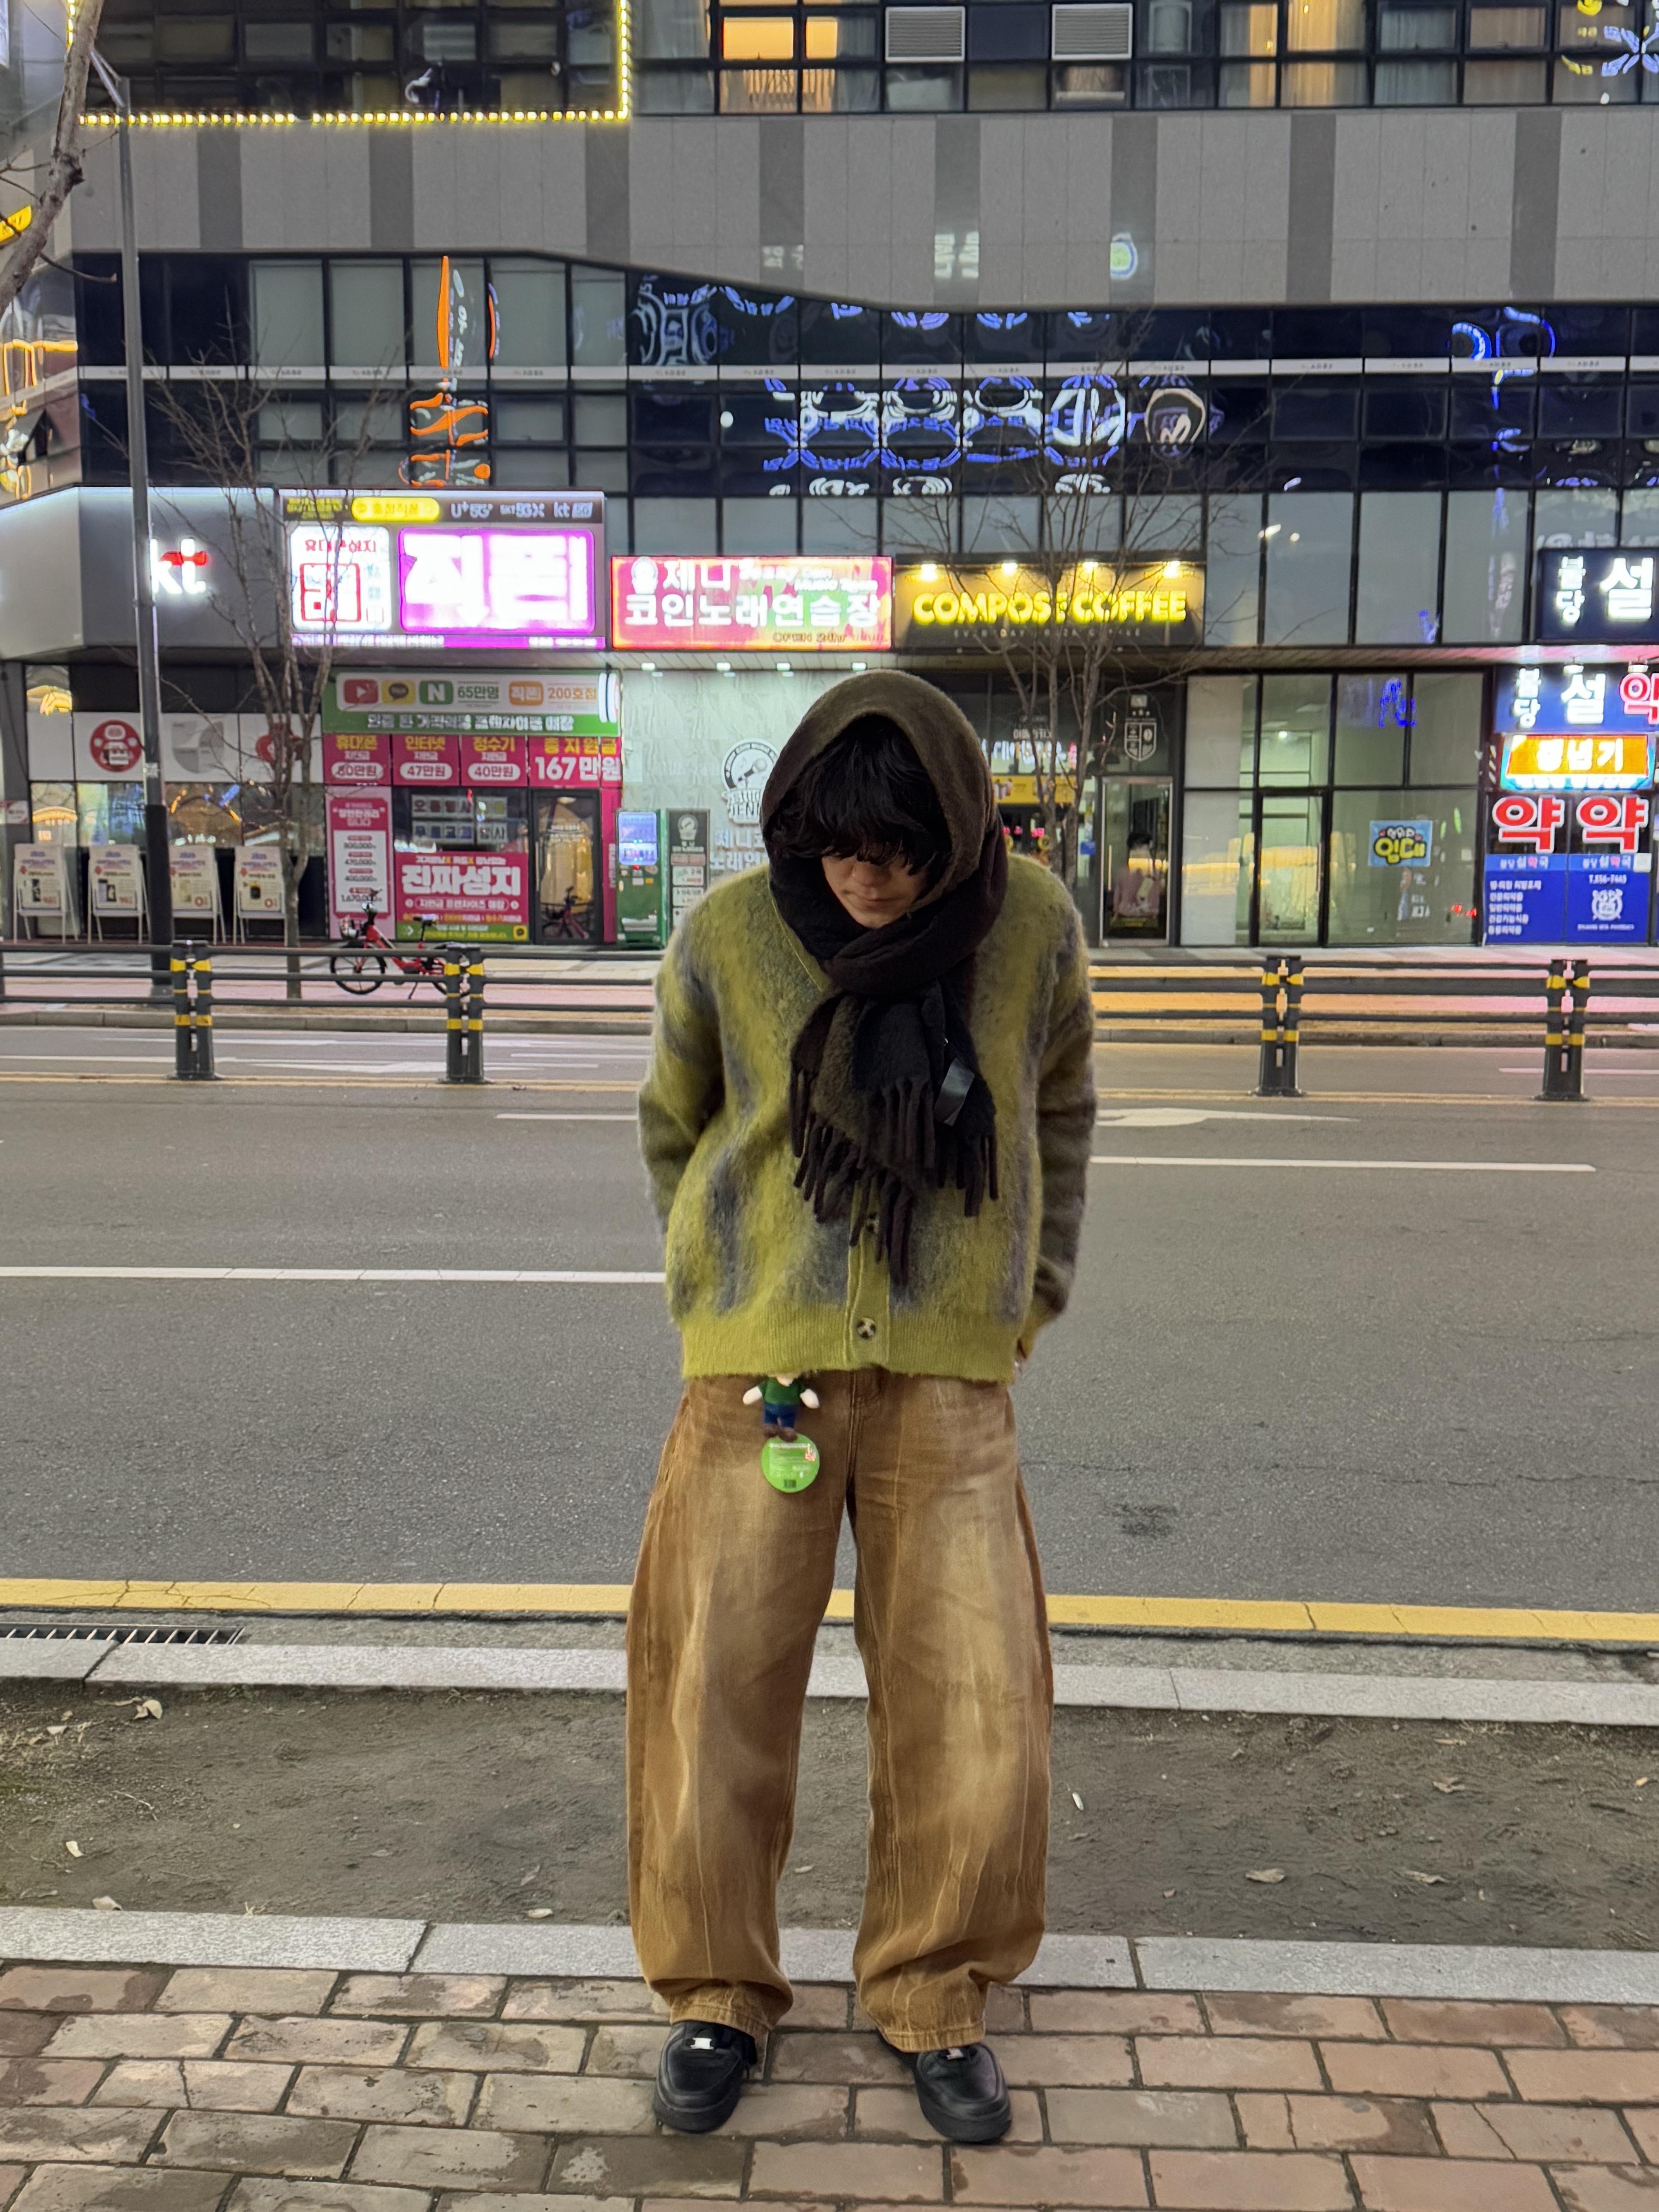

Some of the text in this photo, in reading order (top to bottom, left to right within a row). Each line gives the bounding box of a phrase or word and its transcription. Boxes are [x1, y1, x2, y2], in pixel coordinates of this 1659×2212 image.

[554, 501, 570, 518] kt
[150, 538, 207, 594] kt
[663, 561, 731, 591] 제니
[1599, 558, 1653, 621] 설
[625, 594, 880, 627] 코인노래연습장
[914, 590, 1187, 623] COMPOSE COFFEE
[428, 684, 445, 701] N
[337, 735, 377, 750] 휴대폰
[405, 735, 446, 750] 인터넷
[473, 736, 515, 752] 정수기
[407, 765, 445, 777] 47만원
[474, 766, 514, 778] 40만원
[535, 756, 621, 781] 167만원
[1493, 796, 1565, 853] 약
[1577, 796, 1649, 854] 약
